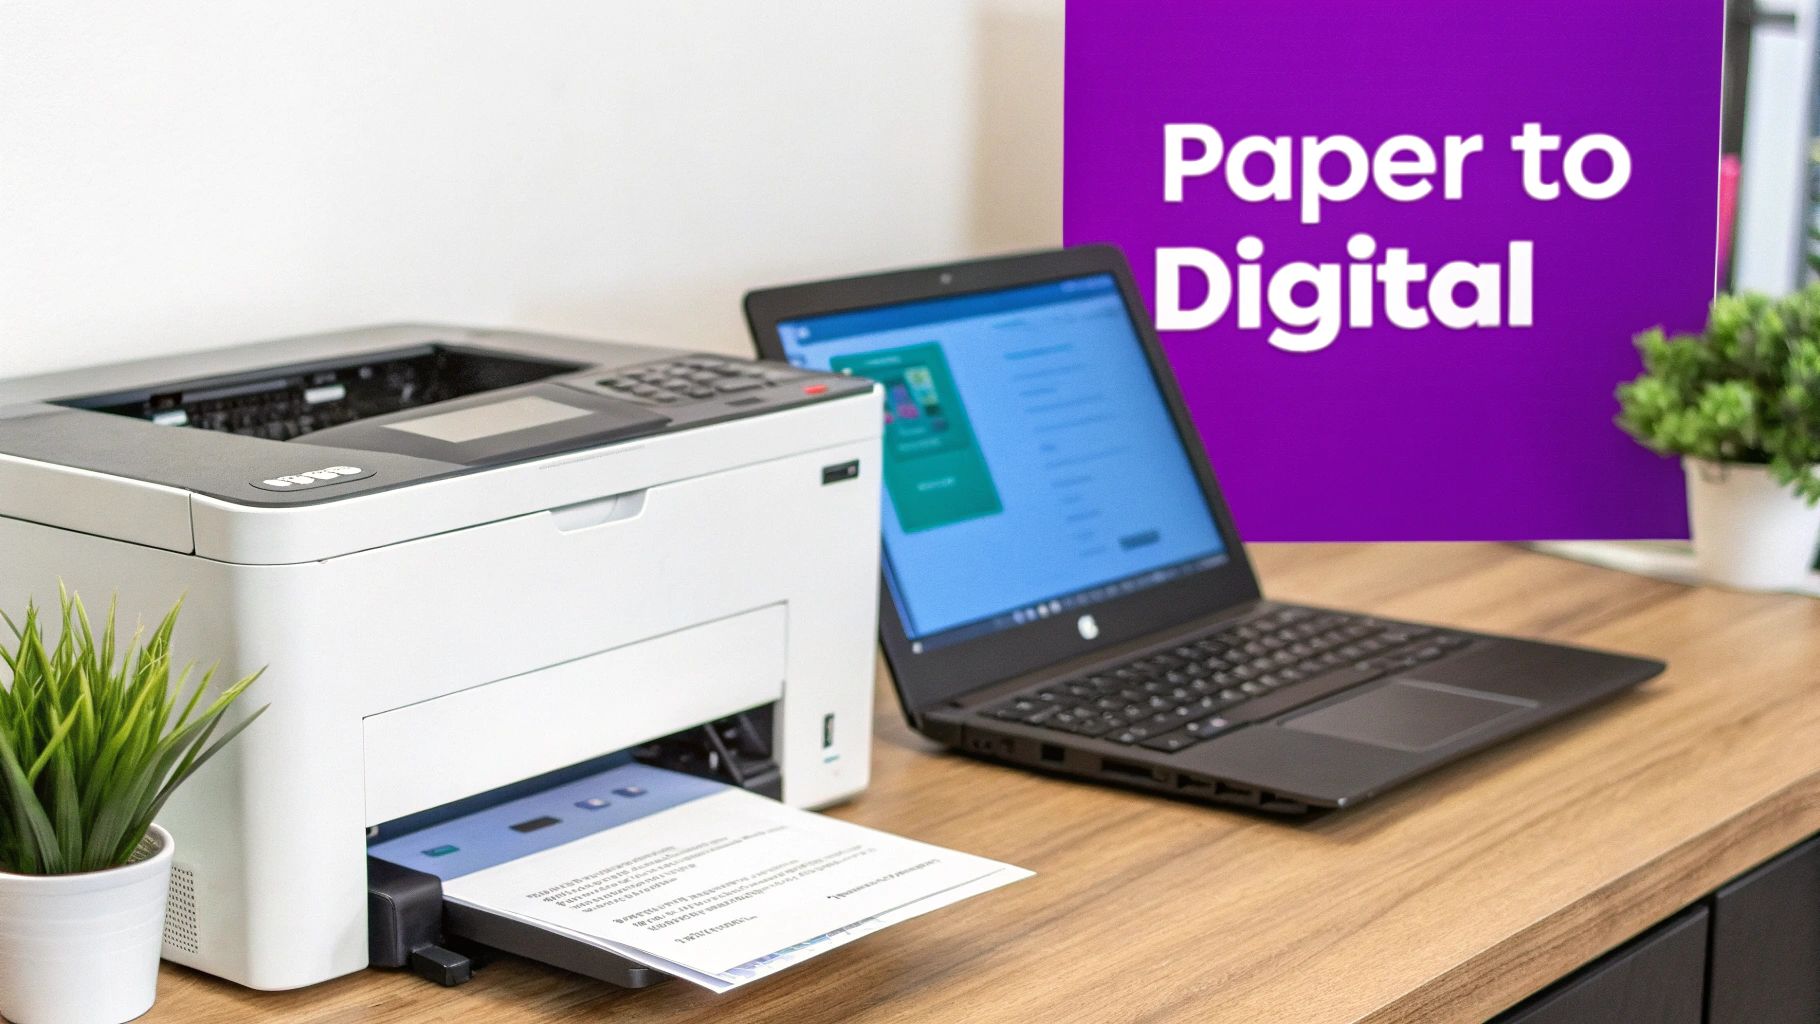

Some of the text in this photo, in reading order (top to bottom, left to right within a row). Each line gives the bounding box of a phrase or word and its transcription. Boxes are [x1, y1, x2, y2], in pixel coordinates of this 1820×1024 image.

[1163, 122, 1632, 224] Paper to
[1155, 233, 1534, 353] Digital
